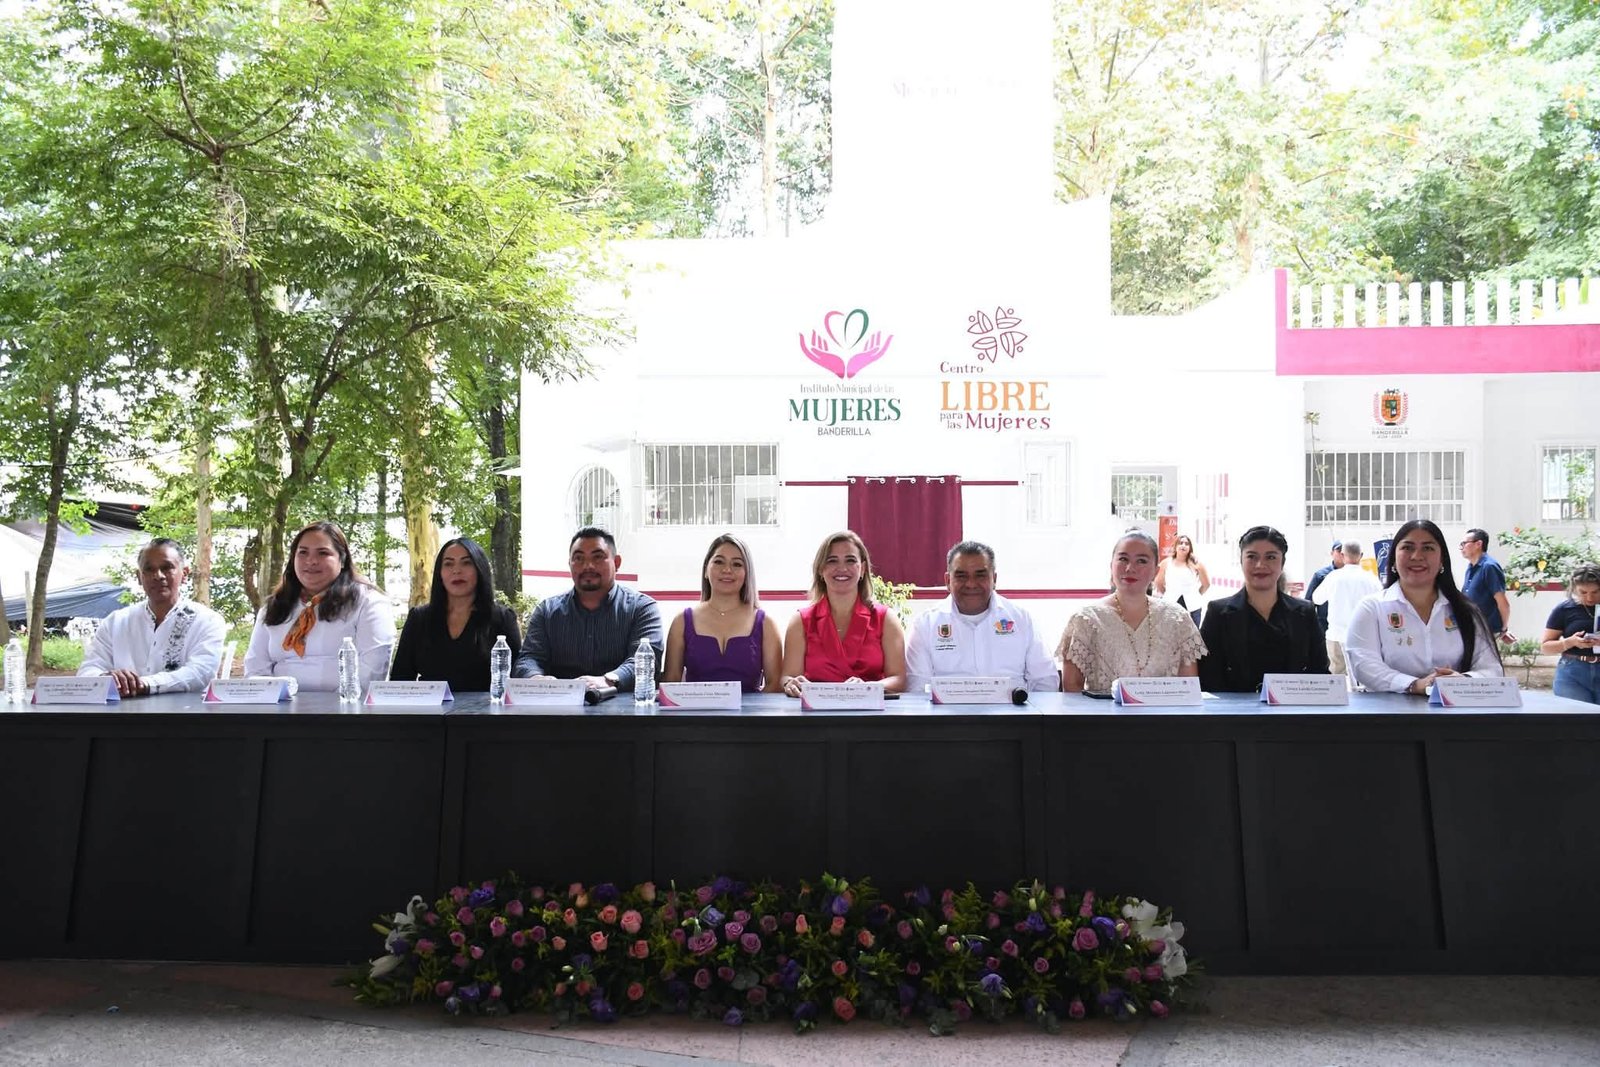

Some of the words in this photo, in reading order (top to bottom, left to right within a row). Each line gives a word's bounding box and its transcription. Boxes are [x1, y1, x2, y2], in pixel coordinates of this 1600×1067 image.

[940, 361, 984, 374] Centro
[800, 384, 835, 394] Instituto
[836, 384, 872, 395] Municipal
[940, 381, 1050, 411] LIBRE
[789, 398, 901, 426] MUJERES
[940, 412, 963, 423] para
[947, 420, 962, 429] las
[965, 412, 1050, 433] Mujeres
[817, 426, 872, 436] BANDERILLA
